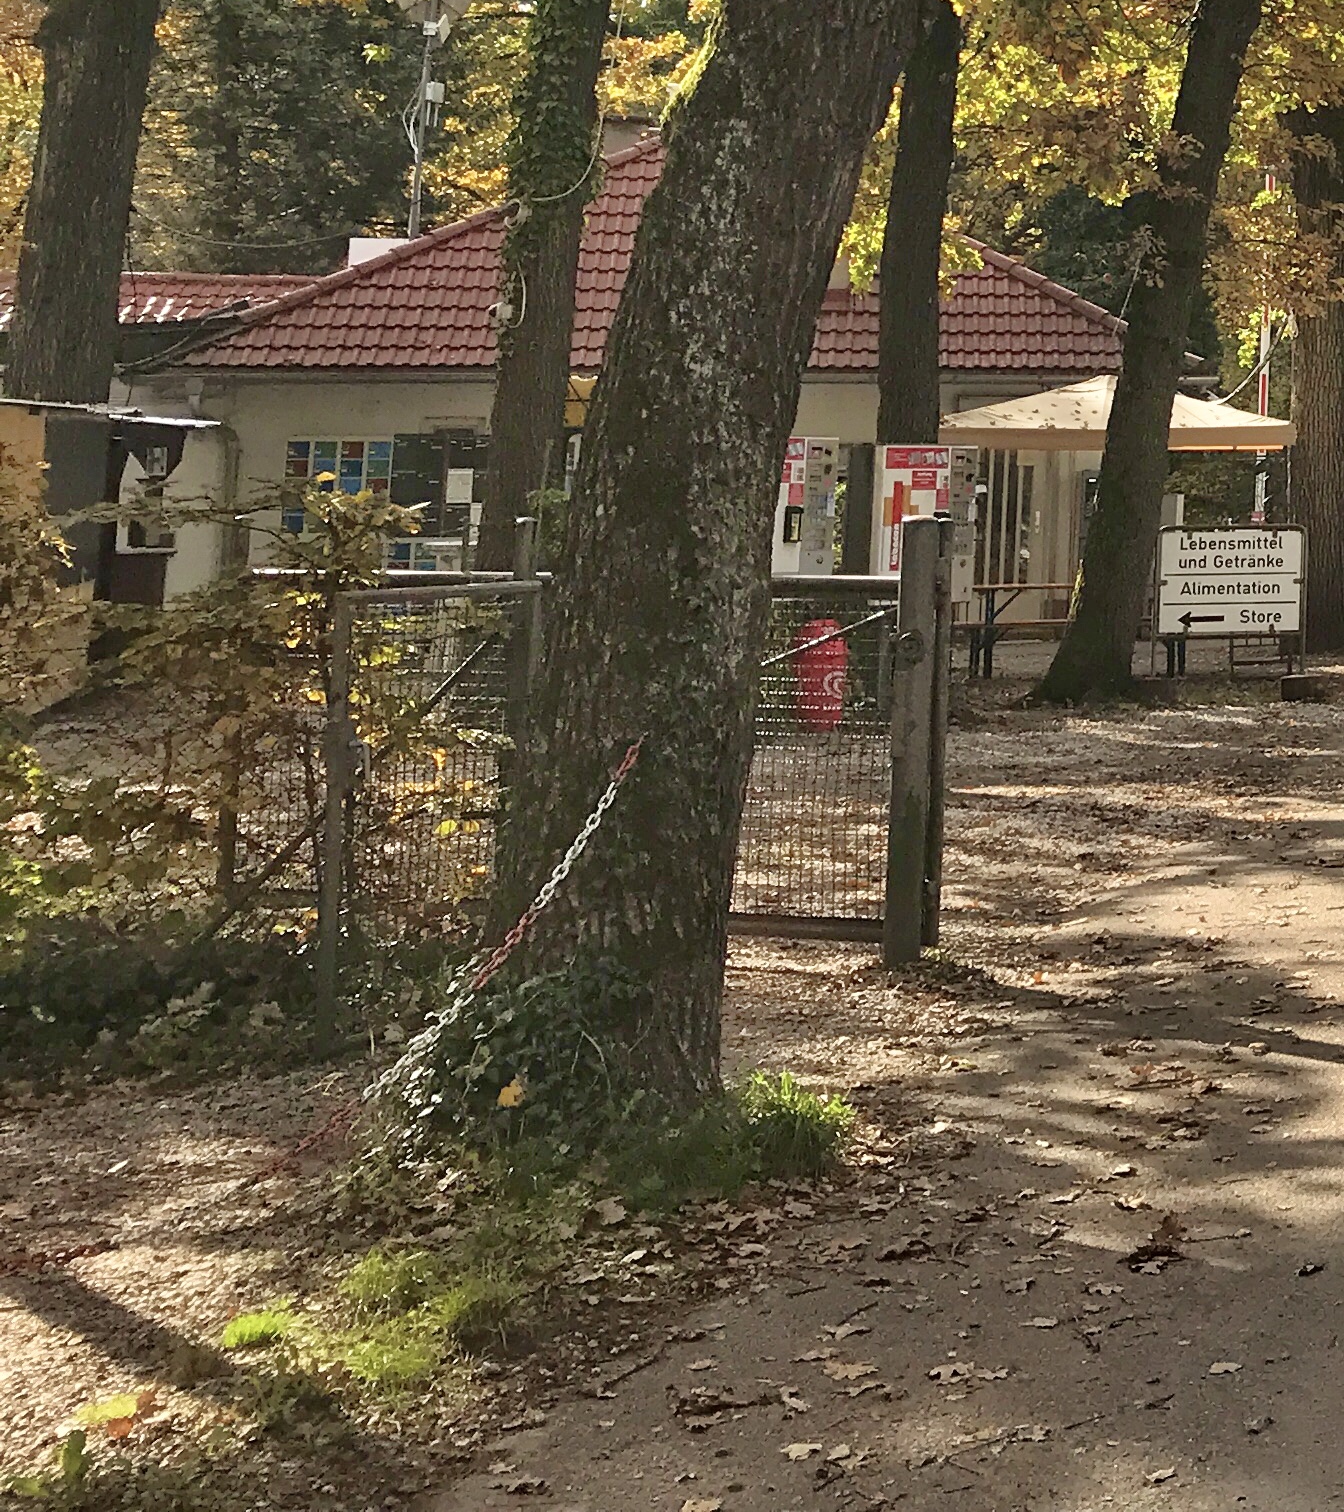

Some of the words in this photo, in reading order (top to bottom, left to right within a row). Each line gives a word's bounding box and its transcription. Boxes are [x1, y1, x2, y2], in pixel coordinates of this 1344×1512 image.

[1180, 536, 1283, 550] Lebensmittel
[1178, 555, 1207, 569] und
[1213, 554, 1284, 569] Getränke
[1180, 580, 1281, 596] Alimentation
[1240, 609, 1282, 624] Store
